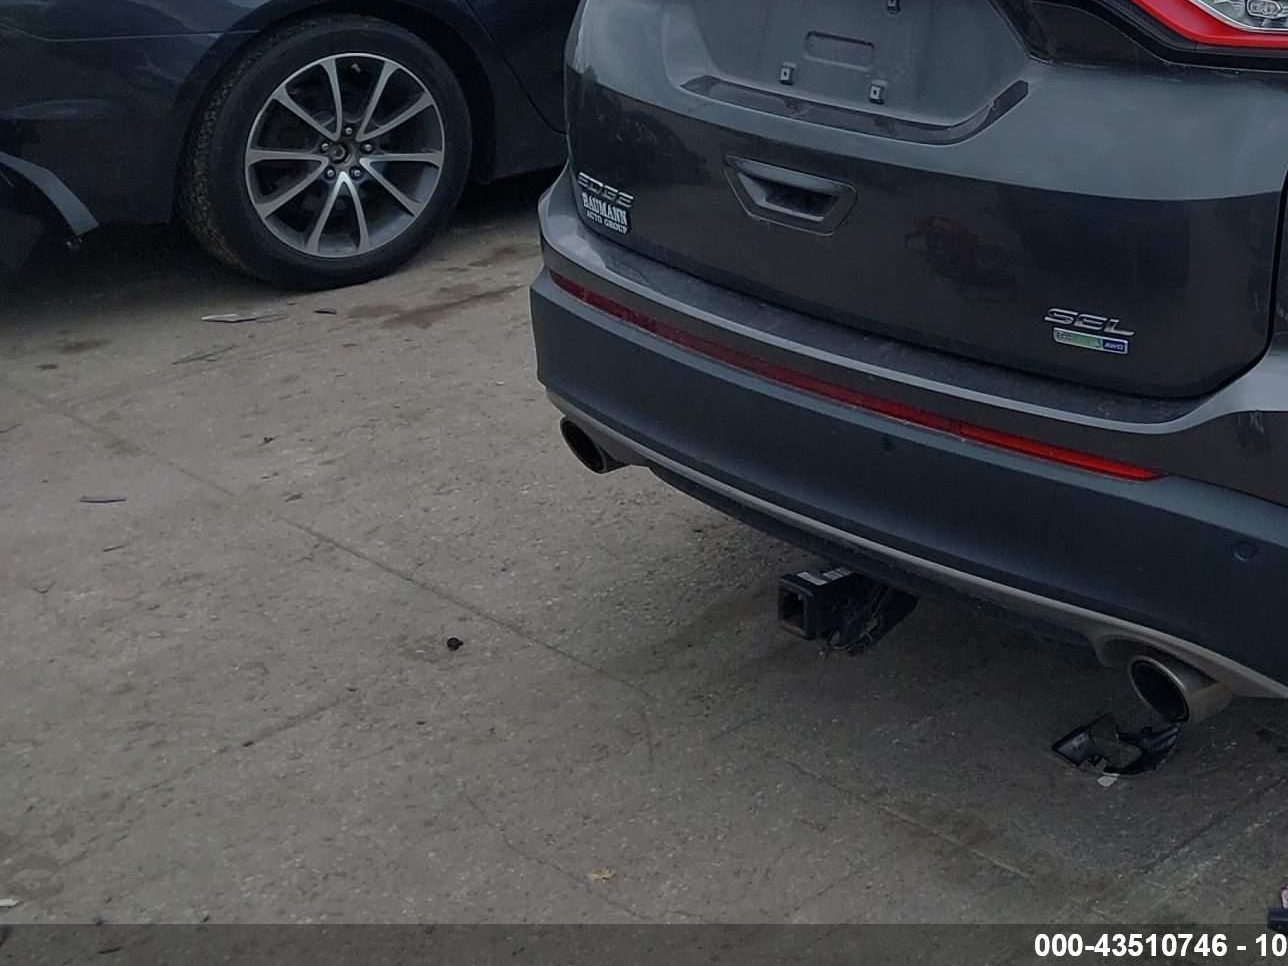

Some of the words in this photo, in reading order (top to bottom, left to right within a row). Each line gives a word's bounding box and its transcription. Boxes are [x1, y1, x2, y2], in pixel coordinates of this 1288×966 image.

[578, 172, 634, 208] EDGE
[582, 192, 627, 226] BAUMANN
[587, 210, 603, 224] AUTO
[604, 219, 627, 234] GROUP
[1044, 308, 1135, 336] SEL
[1104, 342, 1124, 350] AWD
